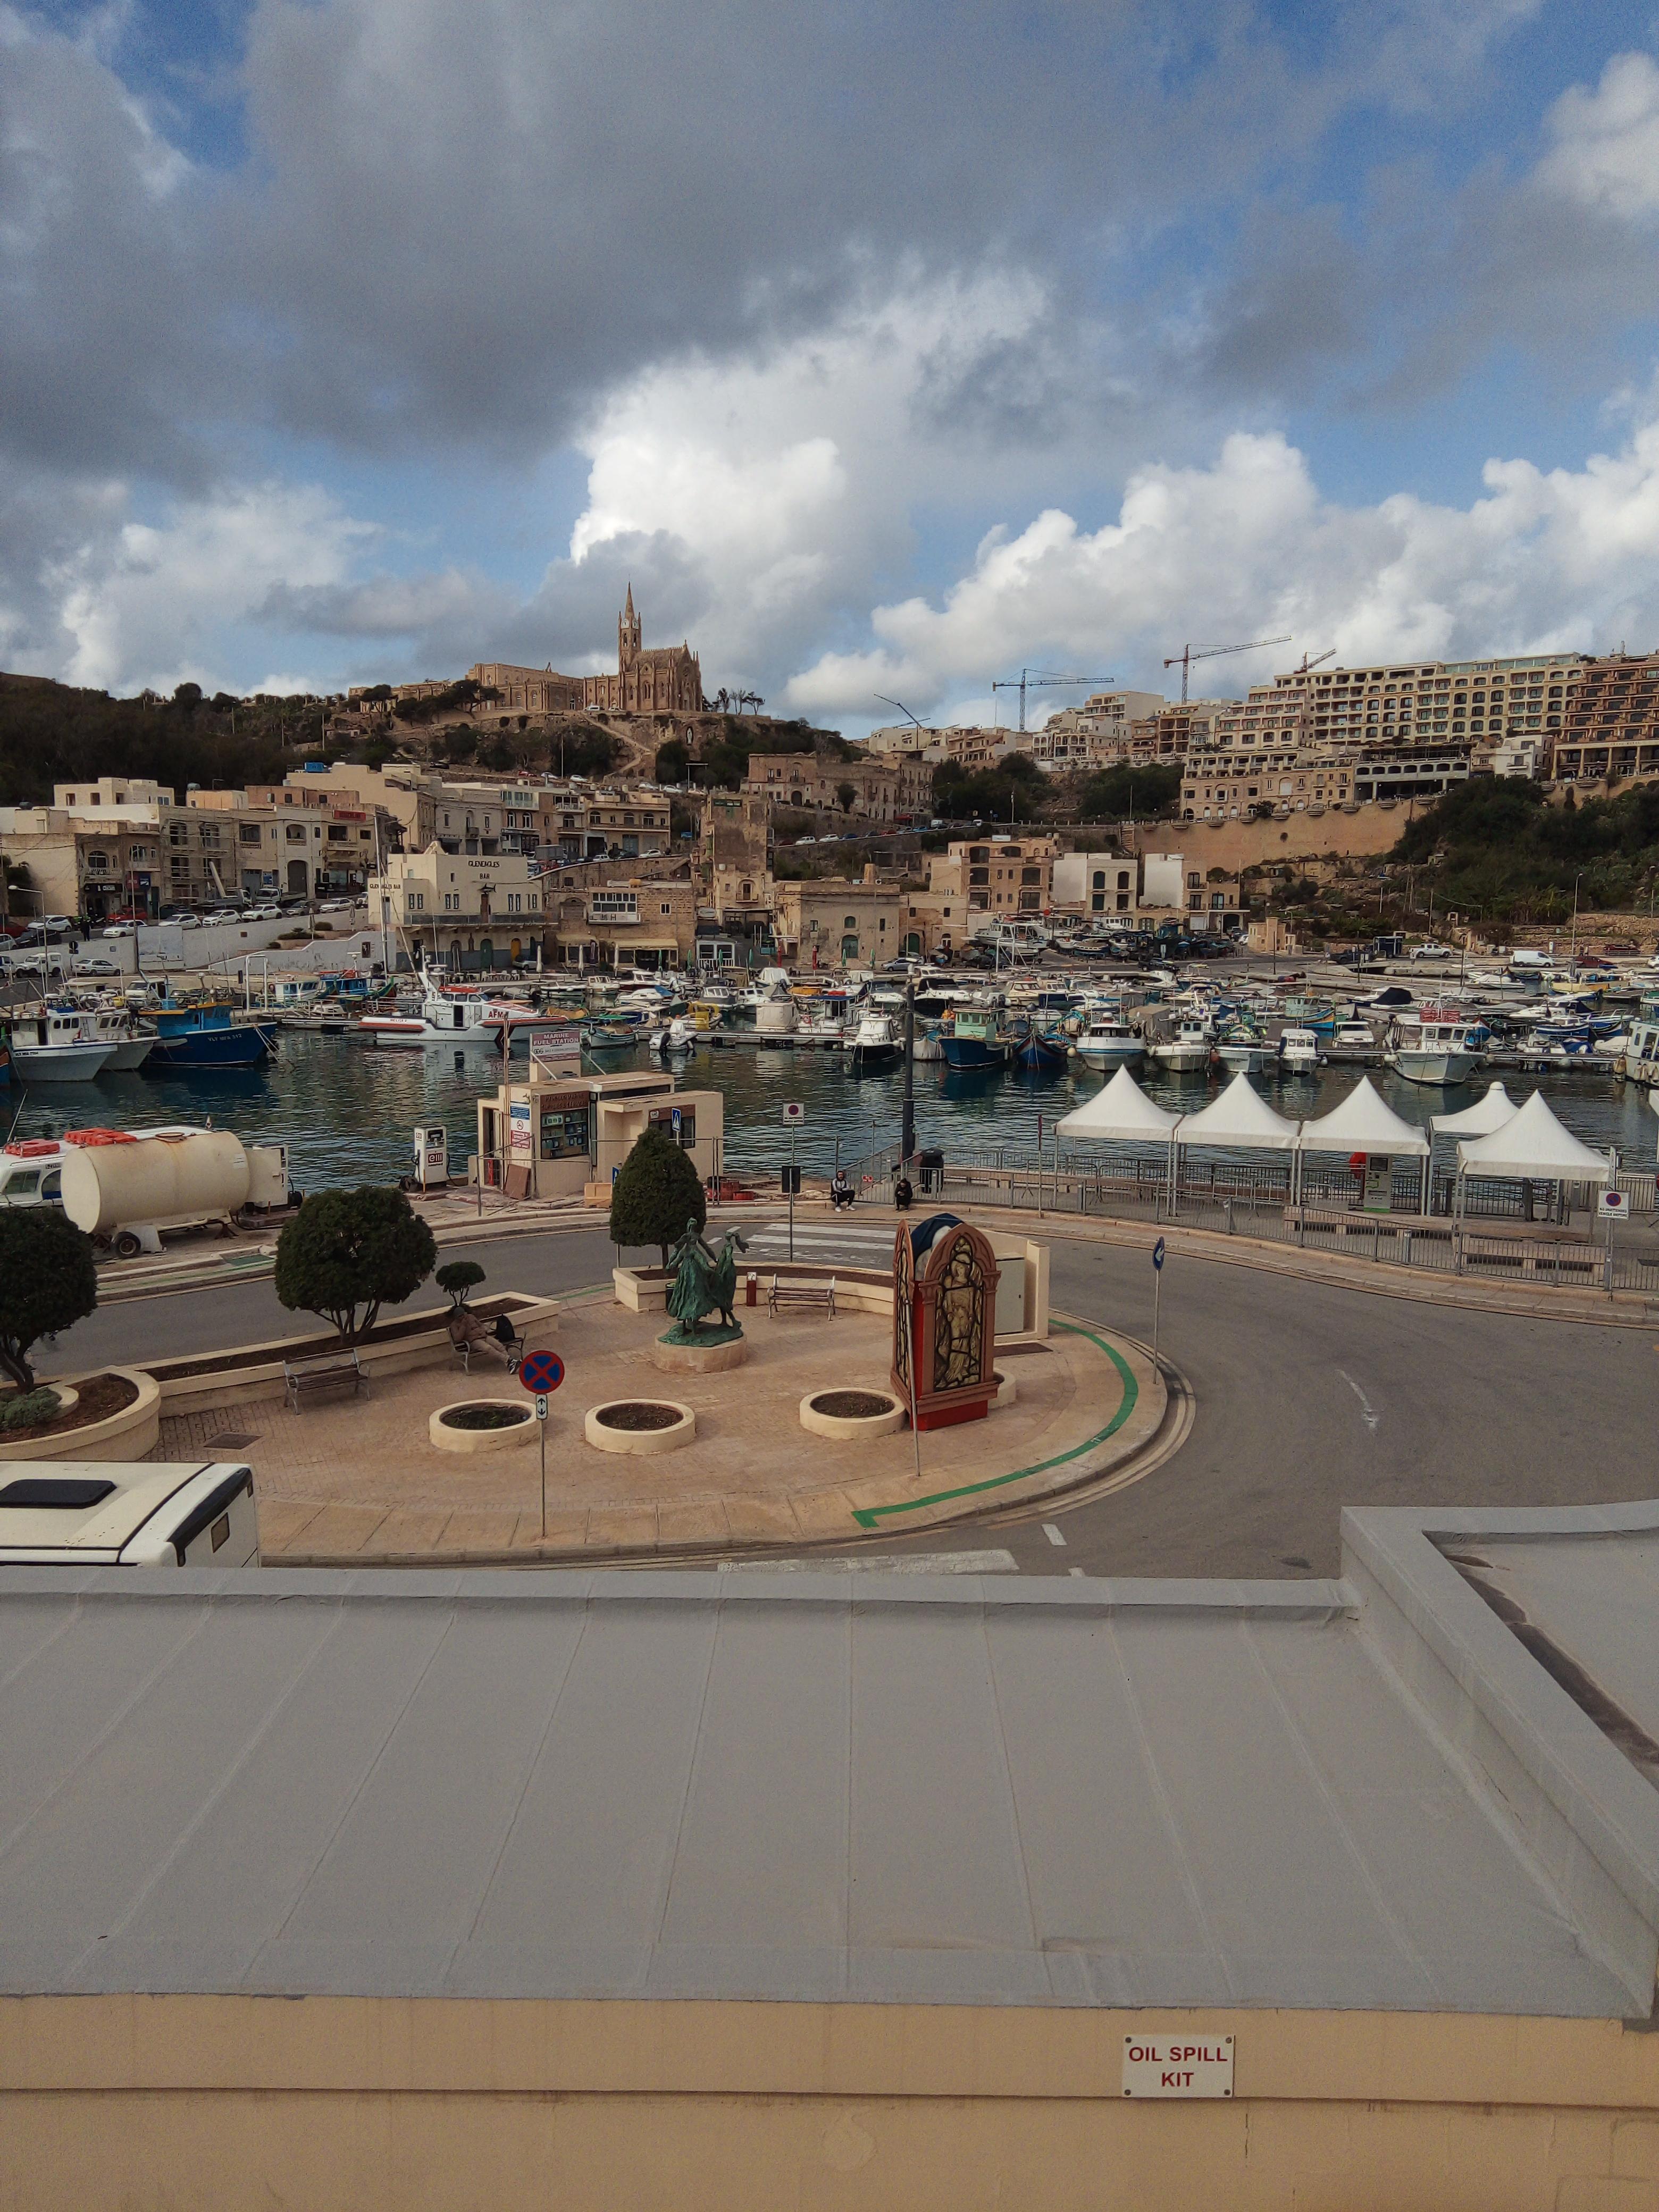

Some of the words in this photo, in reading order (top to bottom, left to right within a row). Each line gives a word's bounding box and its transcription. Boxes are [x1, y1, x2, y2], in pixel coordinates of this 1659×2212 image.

[1129, 2047, 1163, 2062] OIL
[1169, 2047, 1228, 2062] SPILL
[1161, 2072, 1194, 2087] KIT
